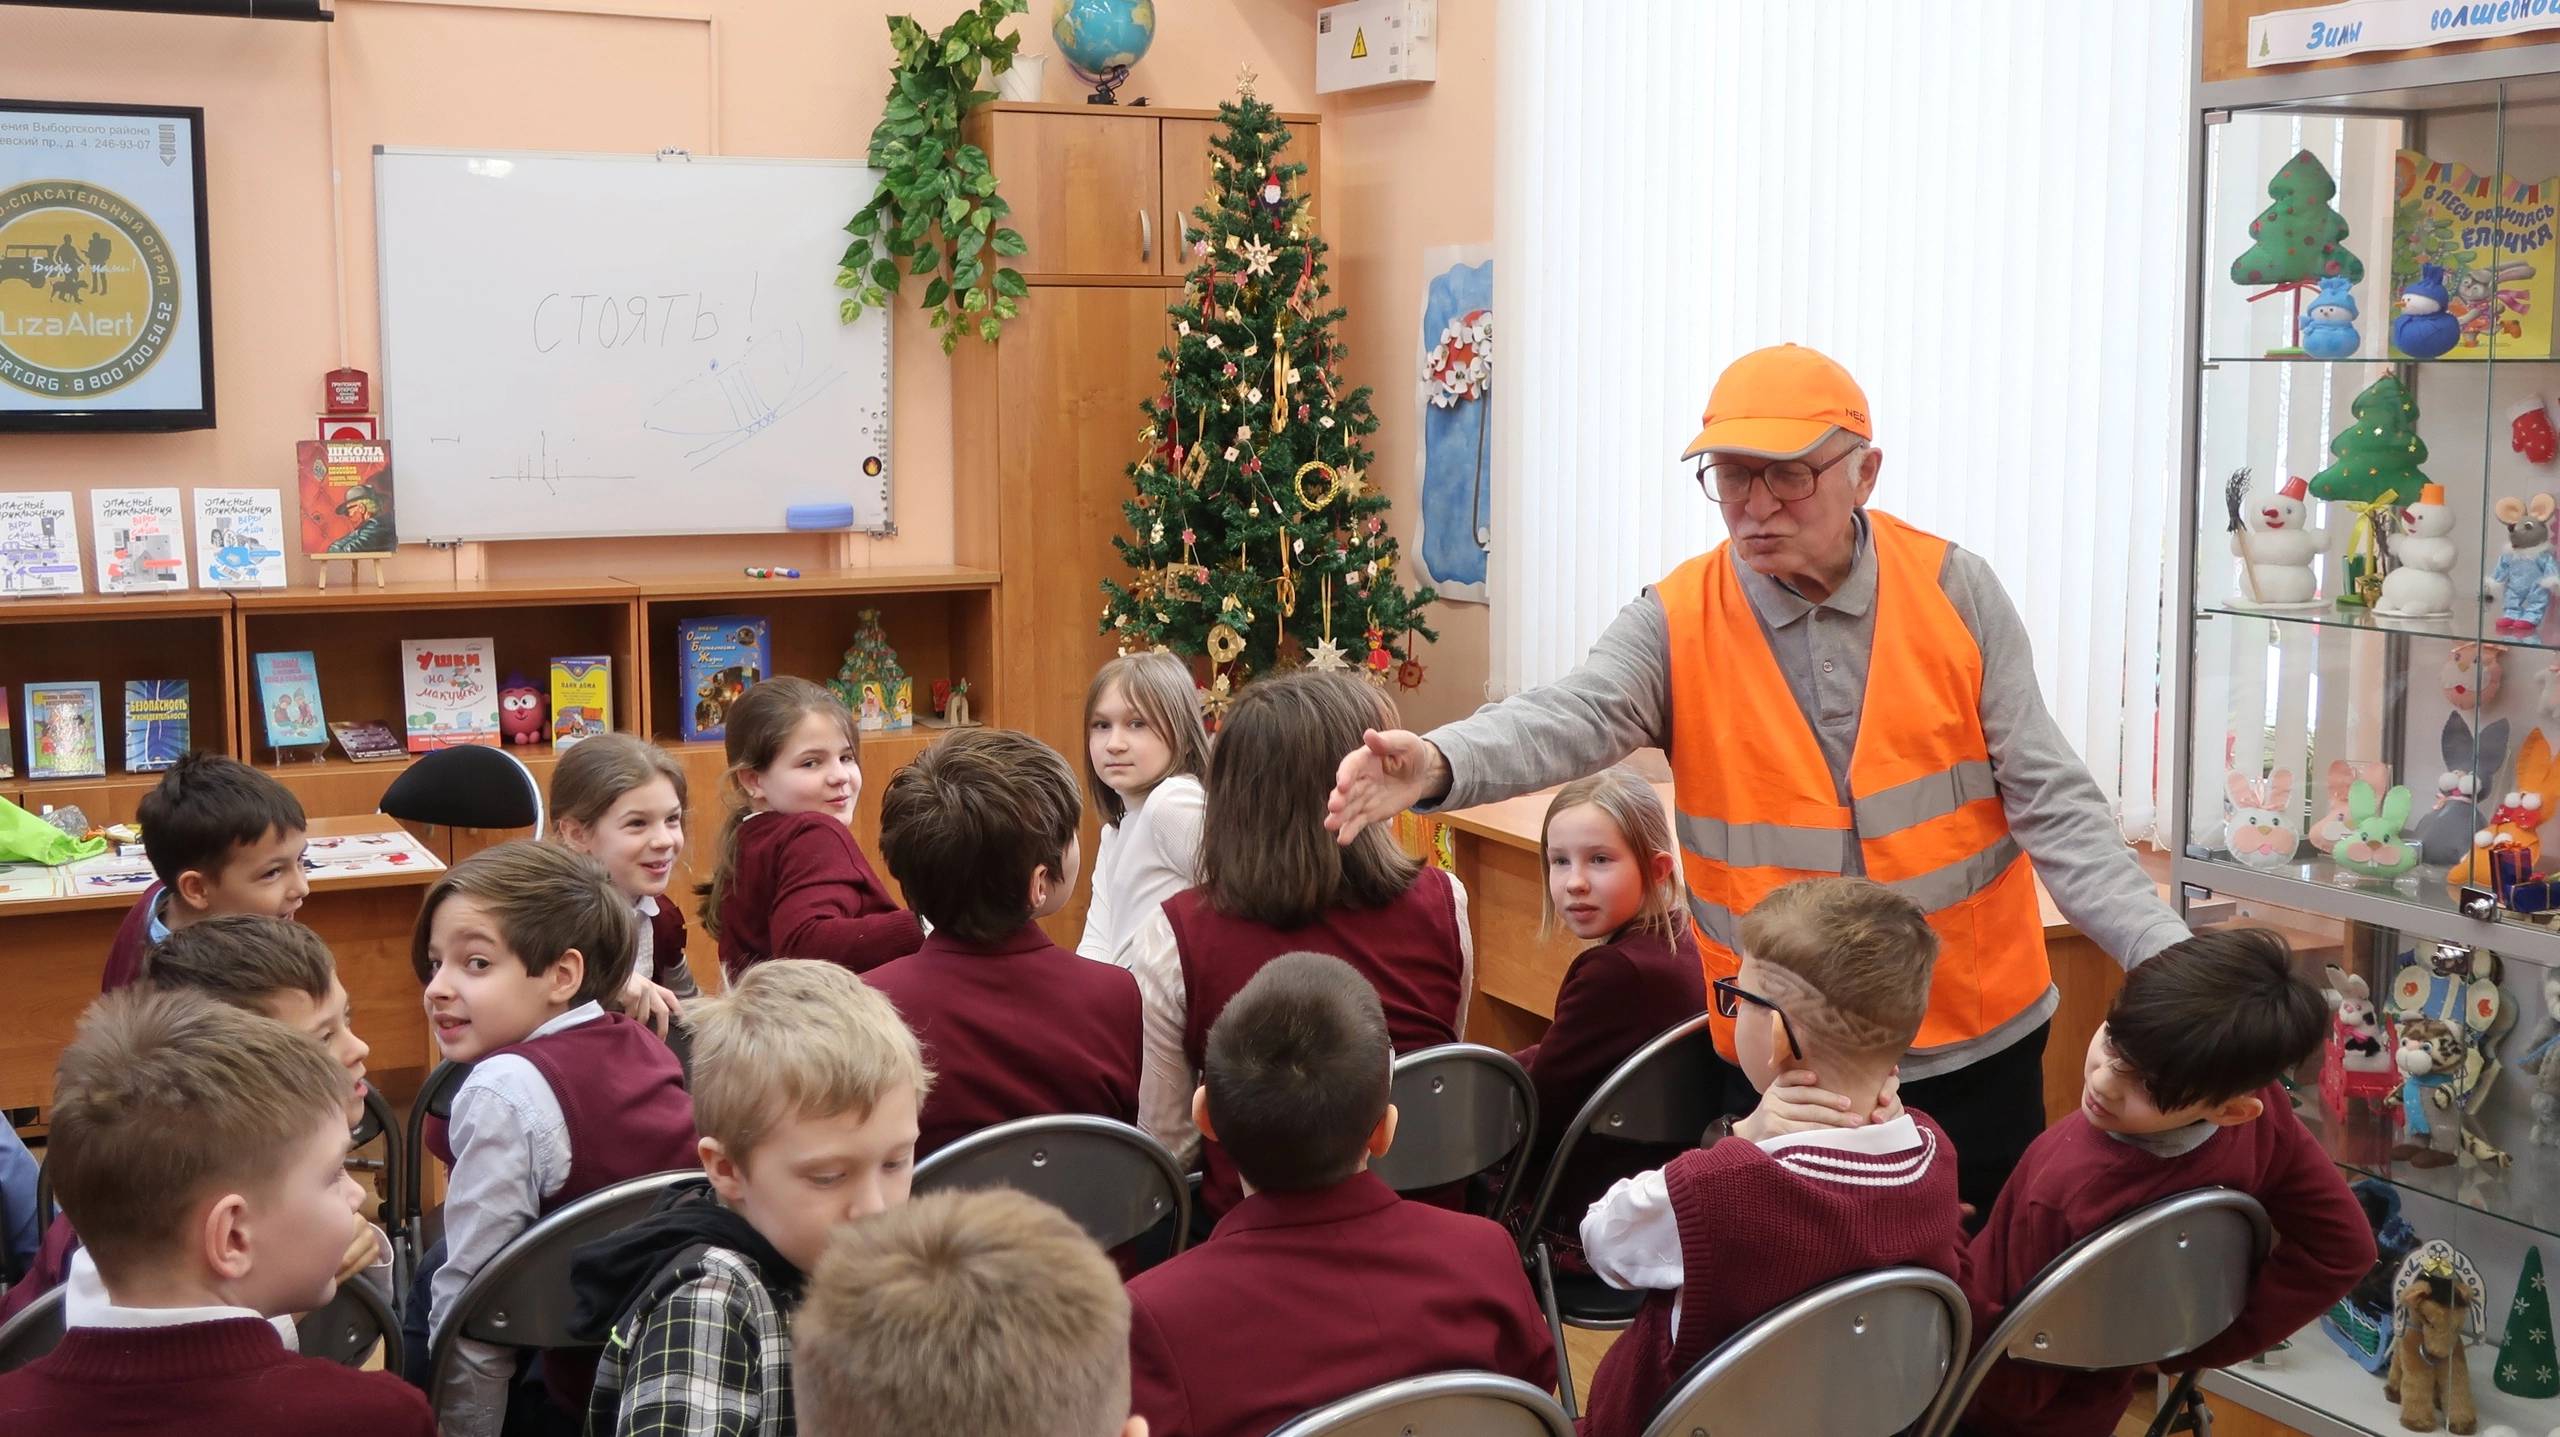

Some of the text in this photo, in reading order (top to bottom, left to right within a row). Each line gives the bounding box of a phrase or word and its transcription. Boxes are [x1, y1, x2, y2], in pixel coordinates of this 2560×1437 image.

[2306, 21, 2363, 50] Зимы
[32, 122, 106, 135] Выборгского
[109, 124, 150, 136] района
[94, 139, 151, 150] 246-93-07
[2423, 185, 2556, 229] В ЛЕСУ РОДИЛАСЬ
[143, 235, 171, 286] ОТРЯД
[0, 311, 135, 337] LizaAlert
[73, 302, 173, 391] 8 800 700 54 52
[328, 446, 384, 456] ШКОЛА
[103, 497, 153, 509] ОПАСНЫЕ
[204, 497, 254, 507] ОПАСНЫЕ
[0, 509, 65, 520] РИКЛЮЧЕНИЯ
[103, 506, 173, 517] ПРИКЛЮЧЕНИЯ
[204, 505, 272, 517] ПРИКЛЮЧЕНИЯ
[416, 684, 484, 707] макушке
[130, 699, 188, 711] БЕЗОПАСНОСТЬ
